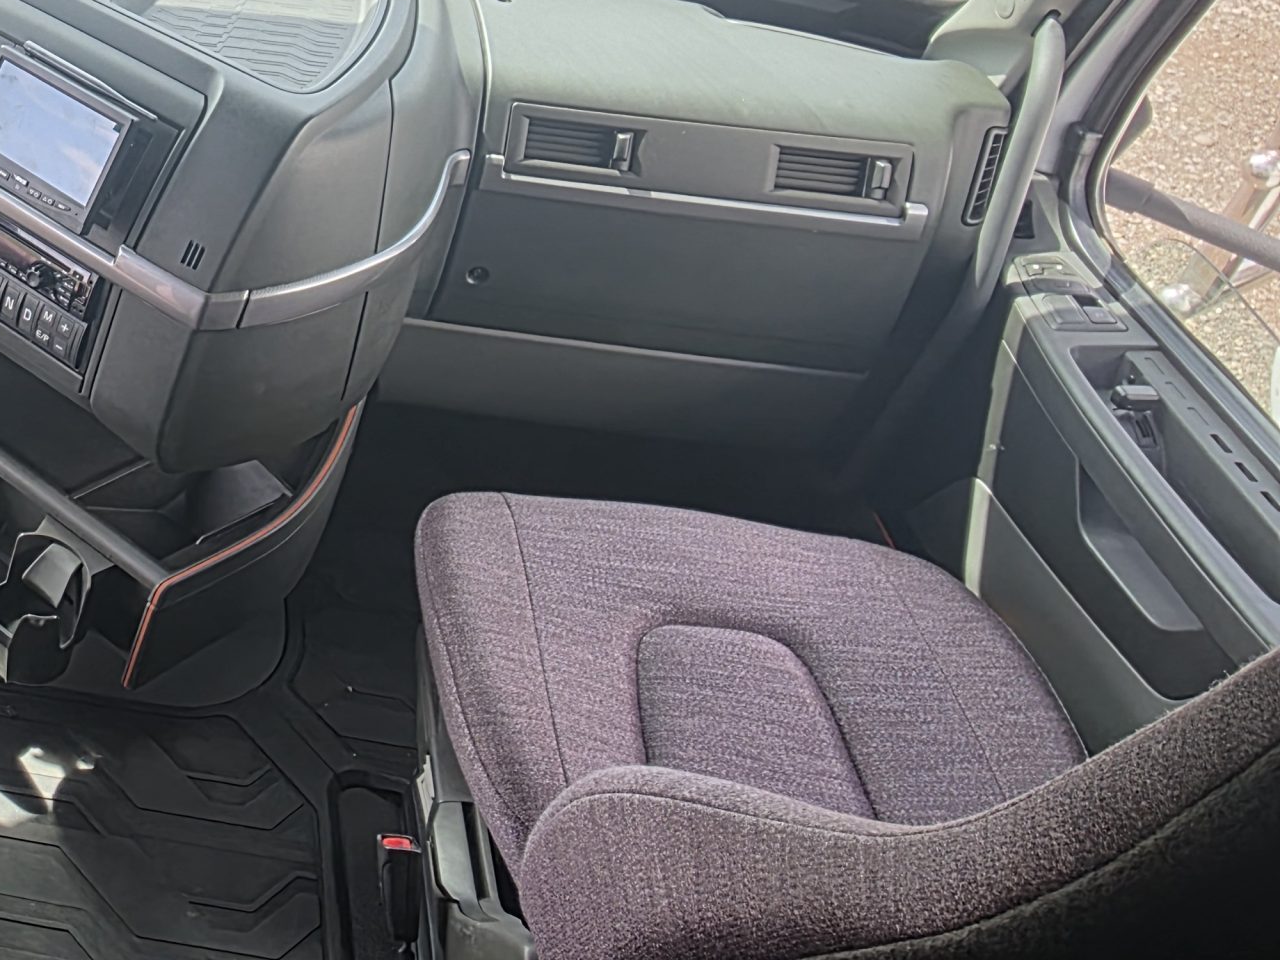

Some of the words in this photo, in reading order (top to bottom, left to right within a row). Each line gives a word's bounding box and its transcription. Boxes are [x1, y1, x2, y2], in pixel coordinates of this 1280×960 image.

[4, 296, 15, 310] N
[23, 308, 32, 321] D
[43, 311, 53, 322] M
[35, 329, 50, 341] E/P
